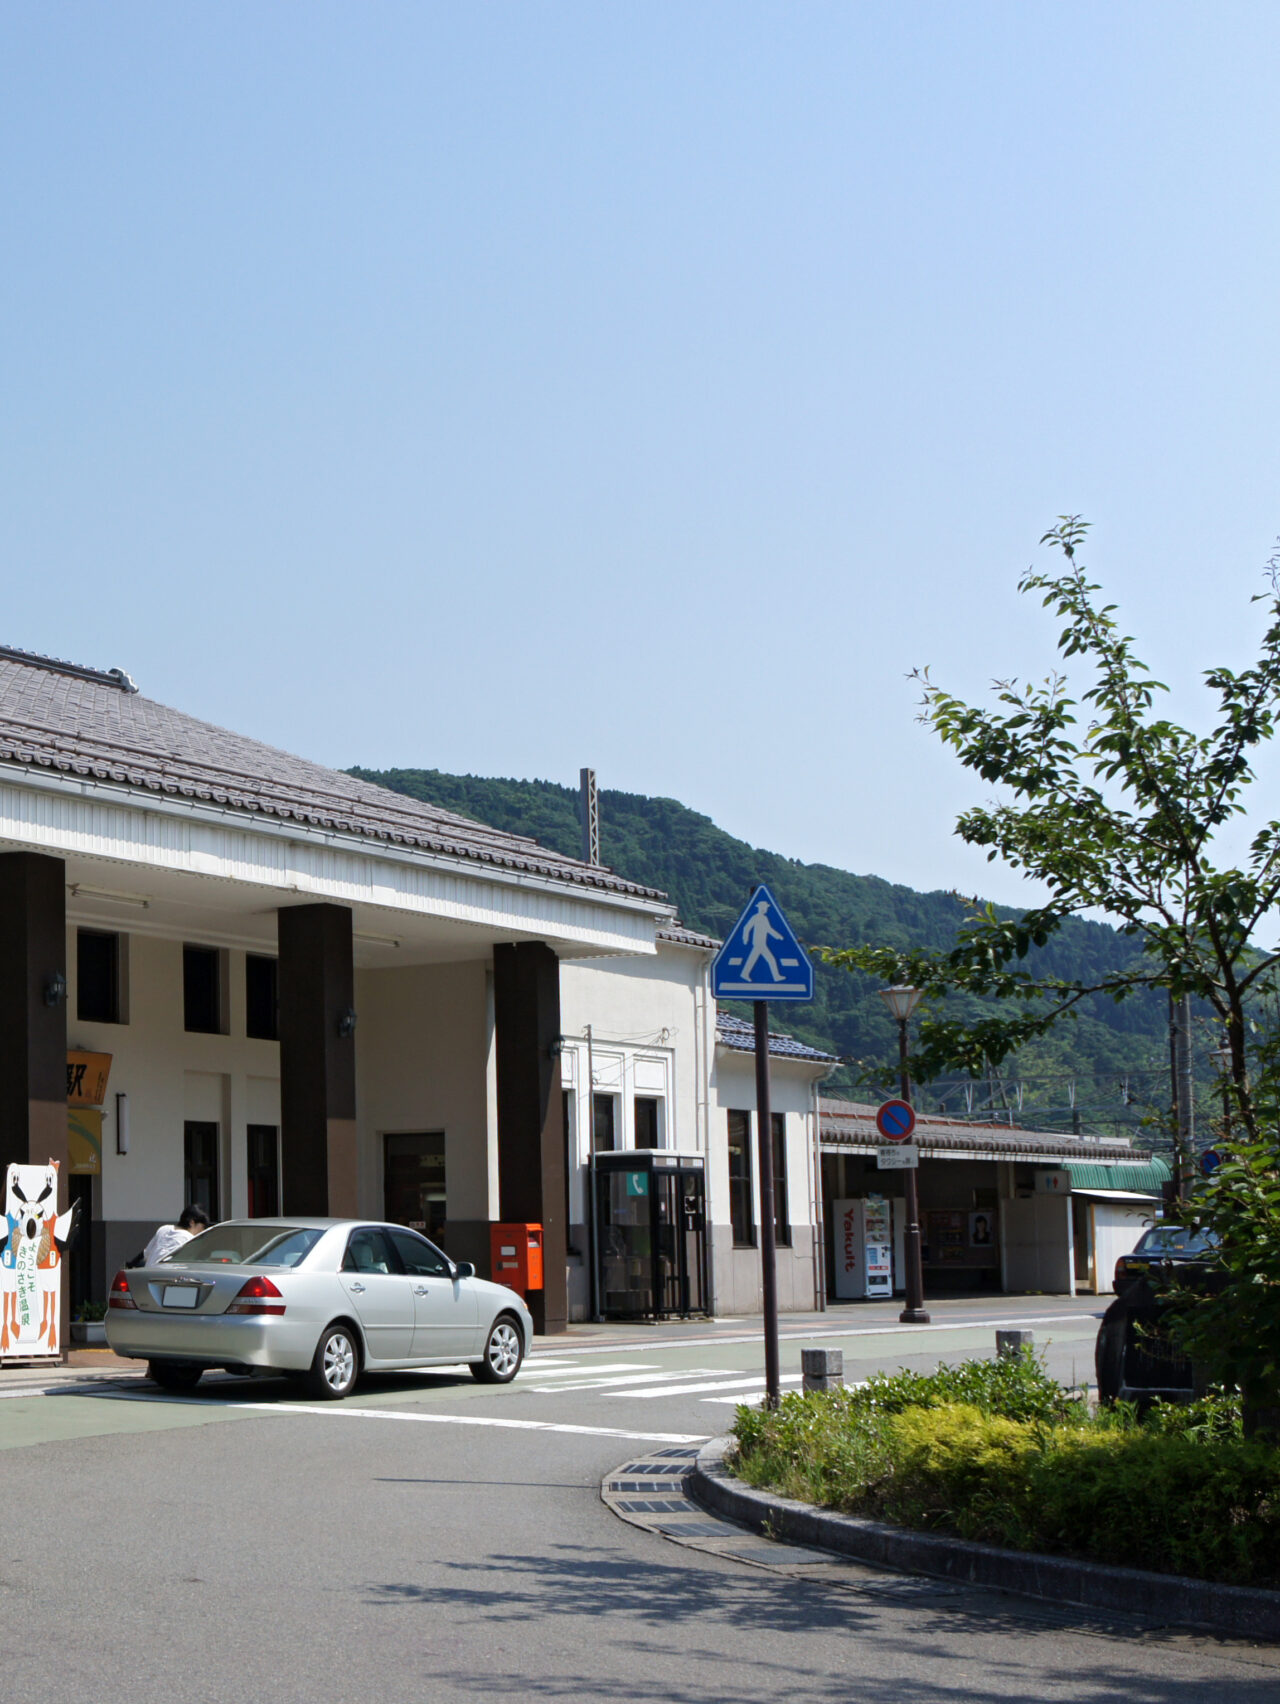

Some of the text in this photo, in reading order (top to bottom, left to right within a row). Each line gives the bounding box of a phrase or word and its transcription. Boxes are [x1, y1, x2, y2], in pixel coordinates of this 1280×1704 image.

[27, 1243, 37, 1292] ようこそ
[843, 1208, 856, 1273] Yakult
